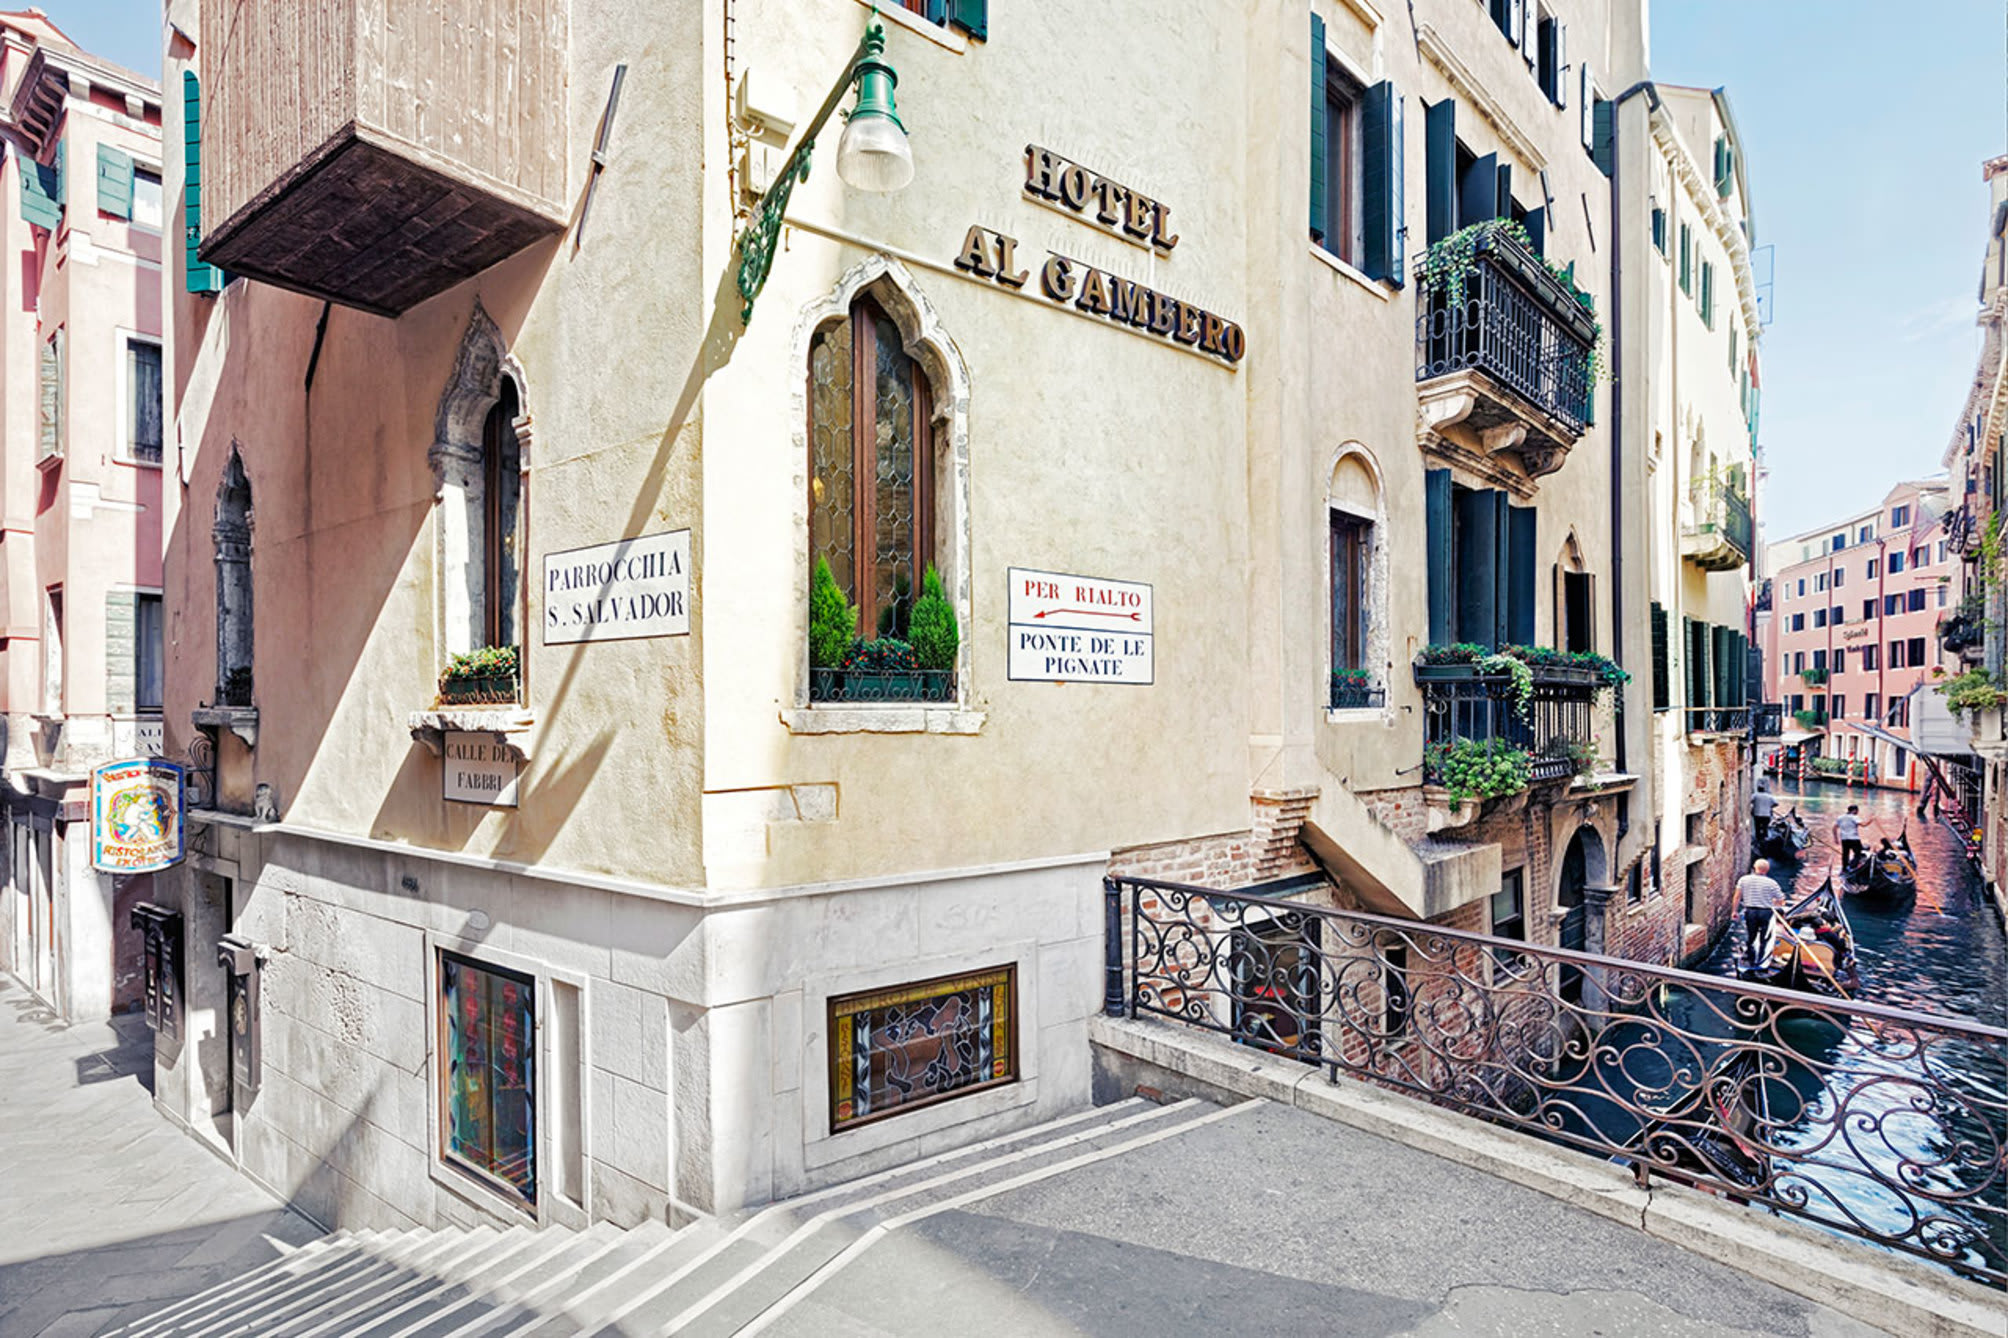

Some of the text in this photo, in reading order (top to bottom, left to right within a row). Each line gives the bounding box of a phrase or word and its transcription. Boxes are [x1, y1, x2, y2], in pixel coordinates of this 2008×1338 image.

[1023, 143, 1179, 250] HOTEL
[953, 224, 1246, 363] AL GAMBERO
[549, 549, 681, 592] PARROCCHIA
[548, 590, 684, 628] S. SALVADOR
[1024, 580, 1142, 608] PER RIALTO
[1020, 633, 1145, 656] PONTE DE LE
[1045, 657, 1123, 676] PIGNATE
[446, 743, 487, 761] CALLE
[457, 772, 502, 792] FABBRI
[841, 993, 911, 1014] BISTROT
[953, 974, 1003, 991] VENISE
